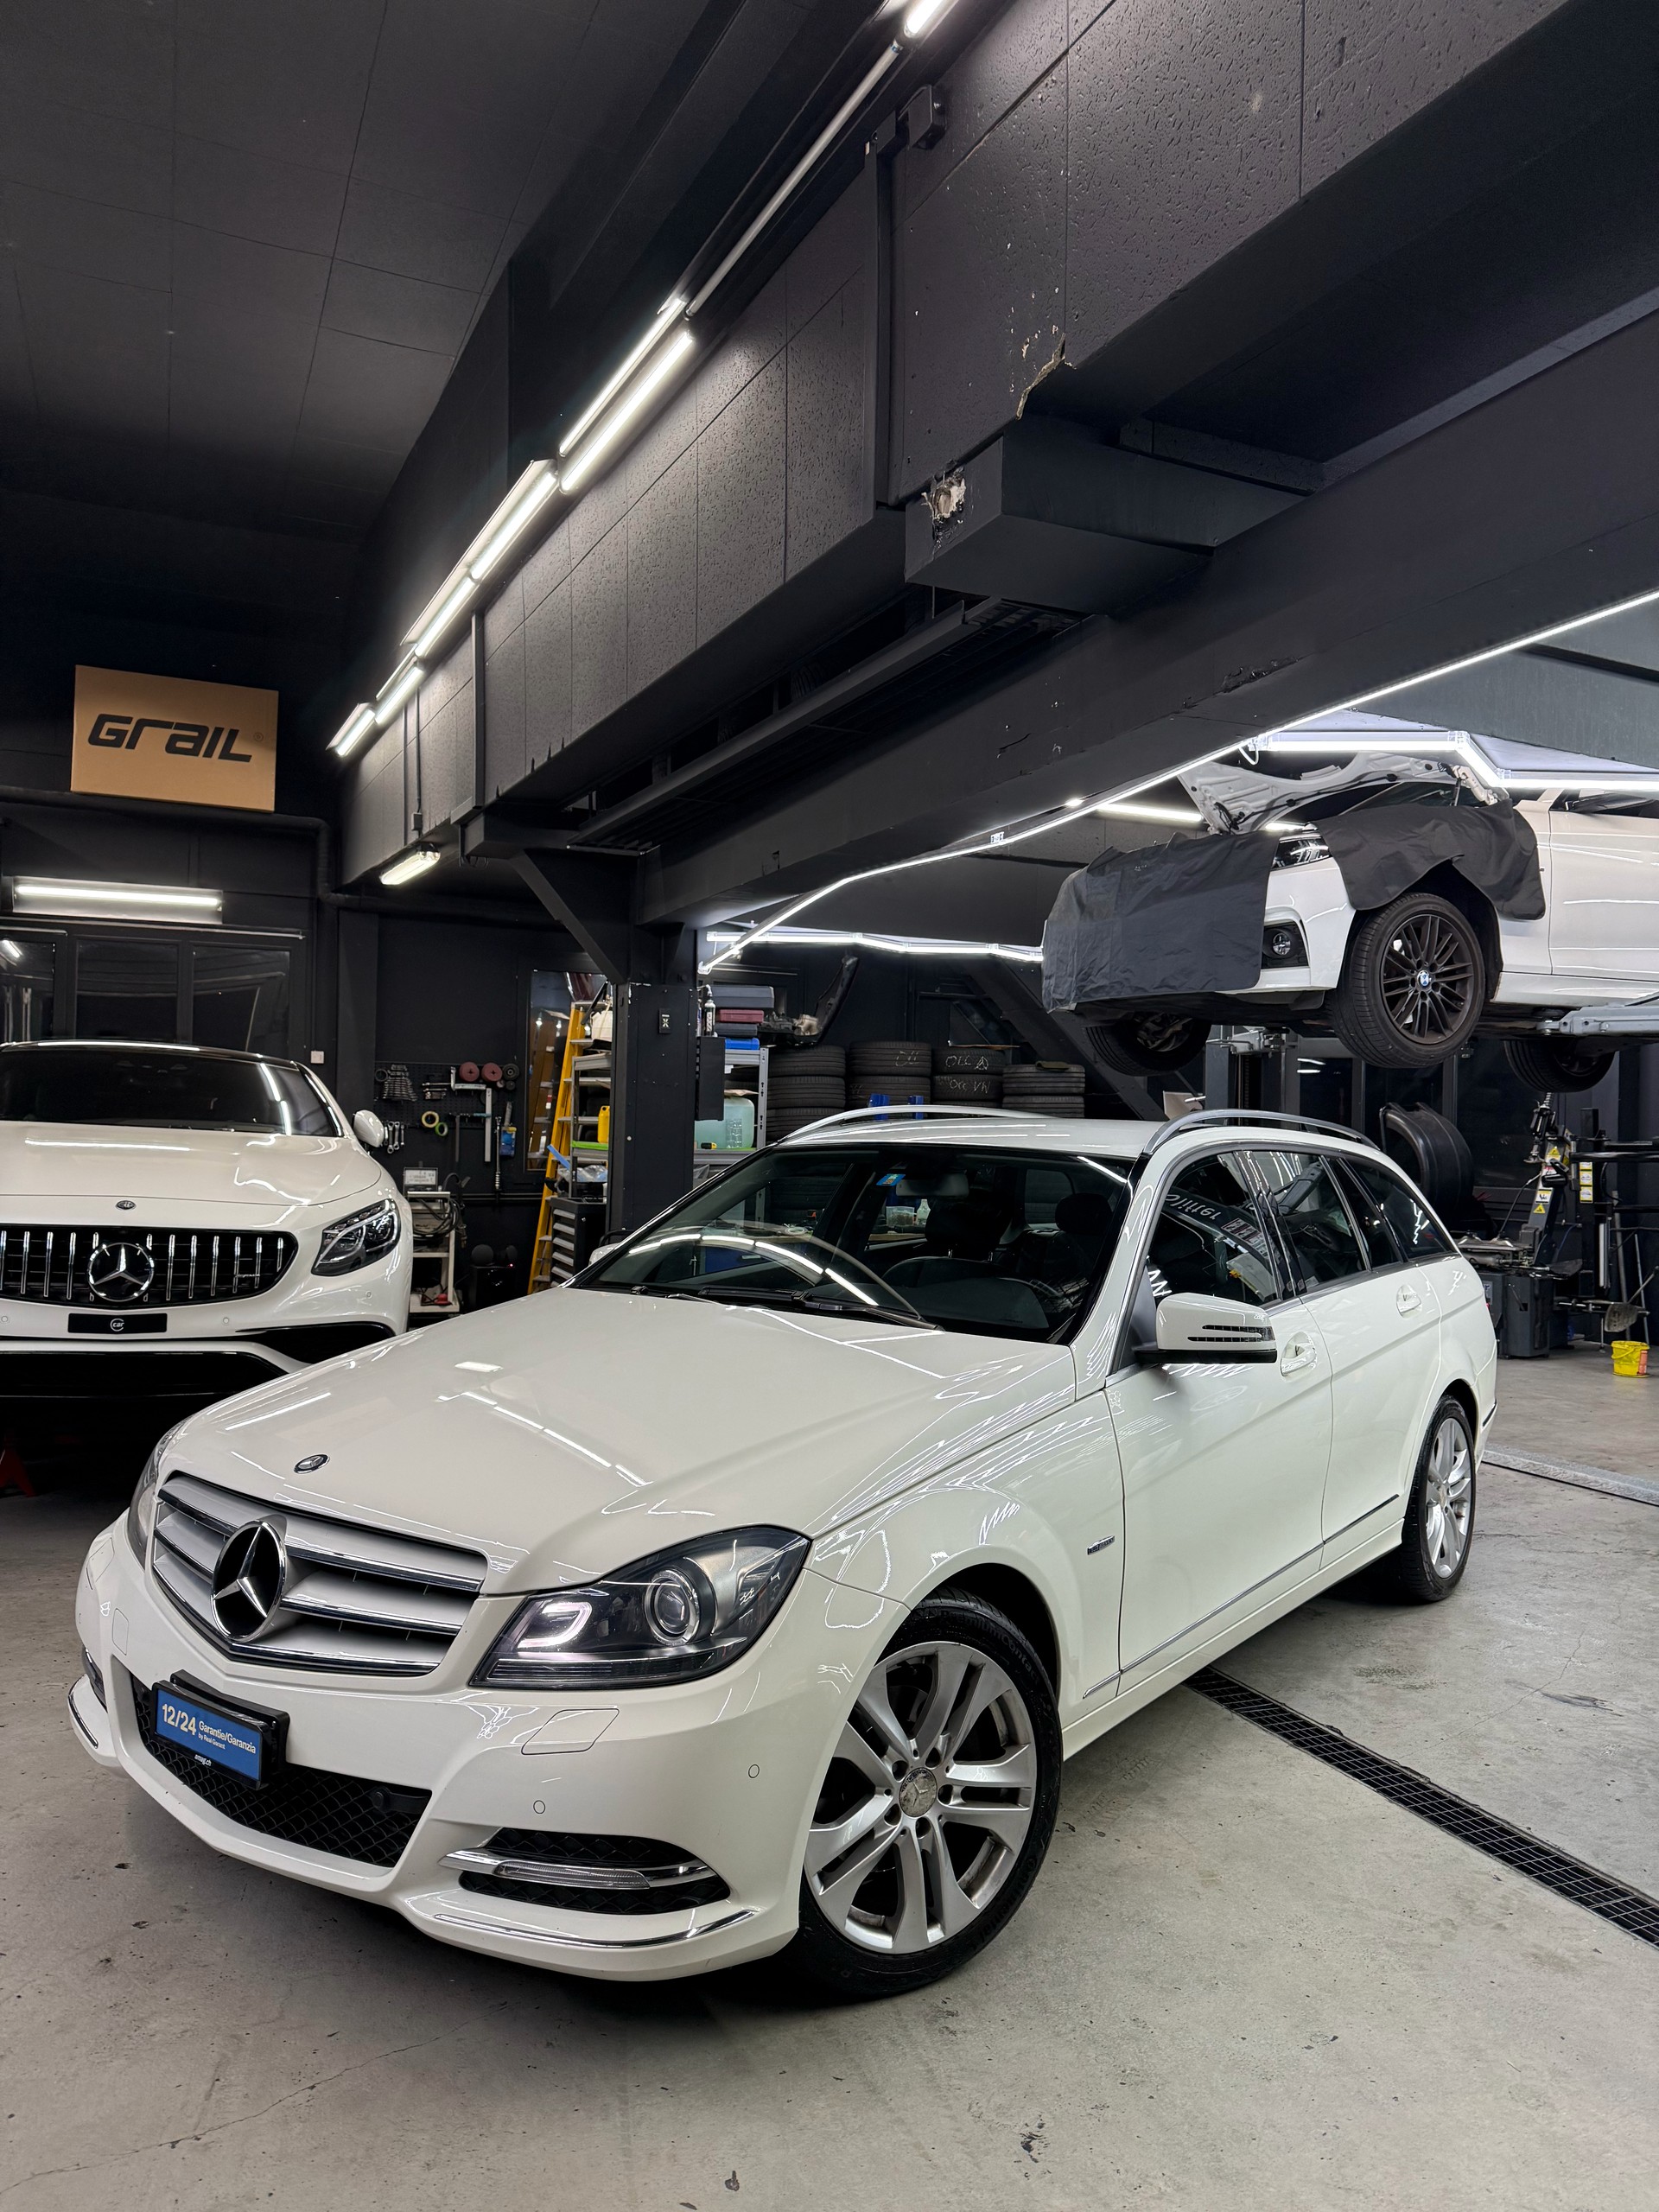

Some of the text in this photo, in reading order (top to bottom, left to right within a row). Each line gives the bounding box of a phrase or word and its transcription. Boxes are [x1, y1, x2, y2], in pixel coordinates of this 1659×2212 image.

[162, 1703, 197, 1736] 12/24
[198, 1720, 257, 1754] Garantie/Garanzia
[198, 1732, 226, 1750] by Real Garant
